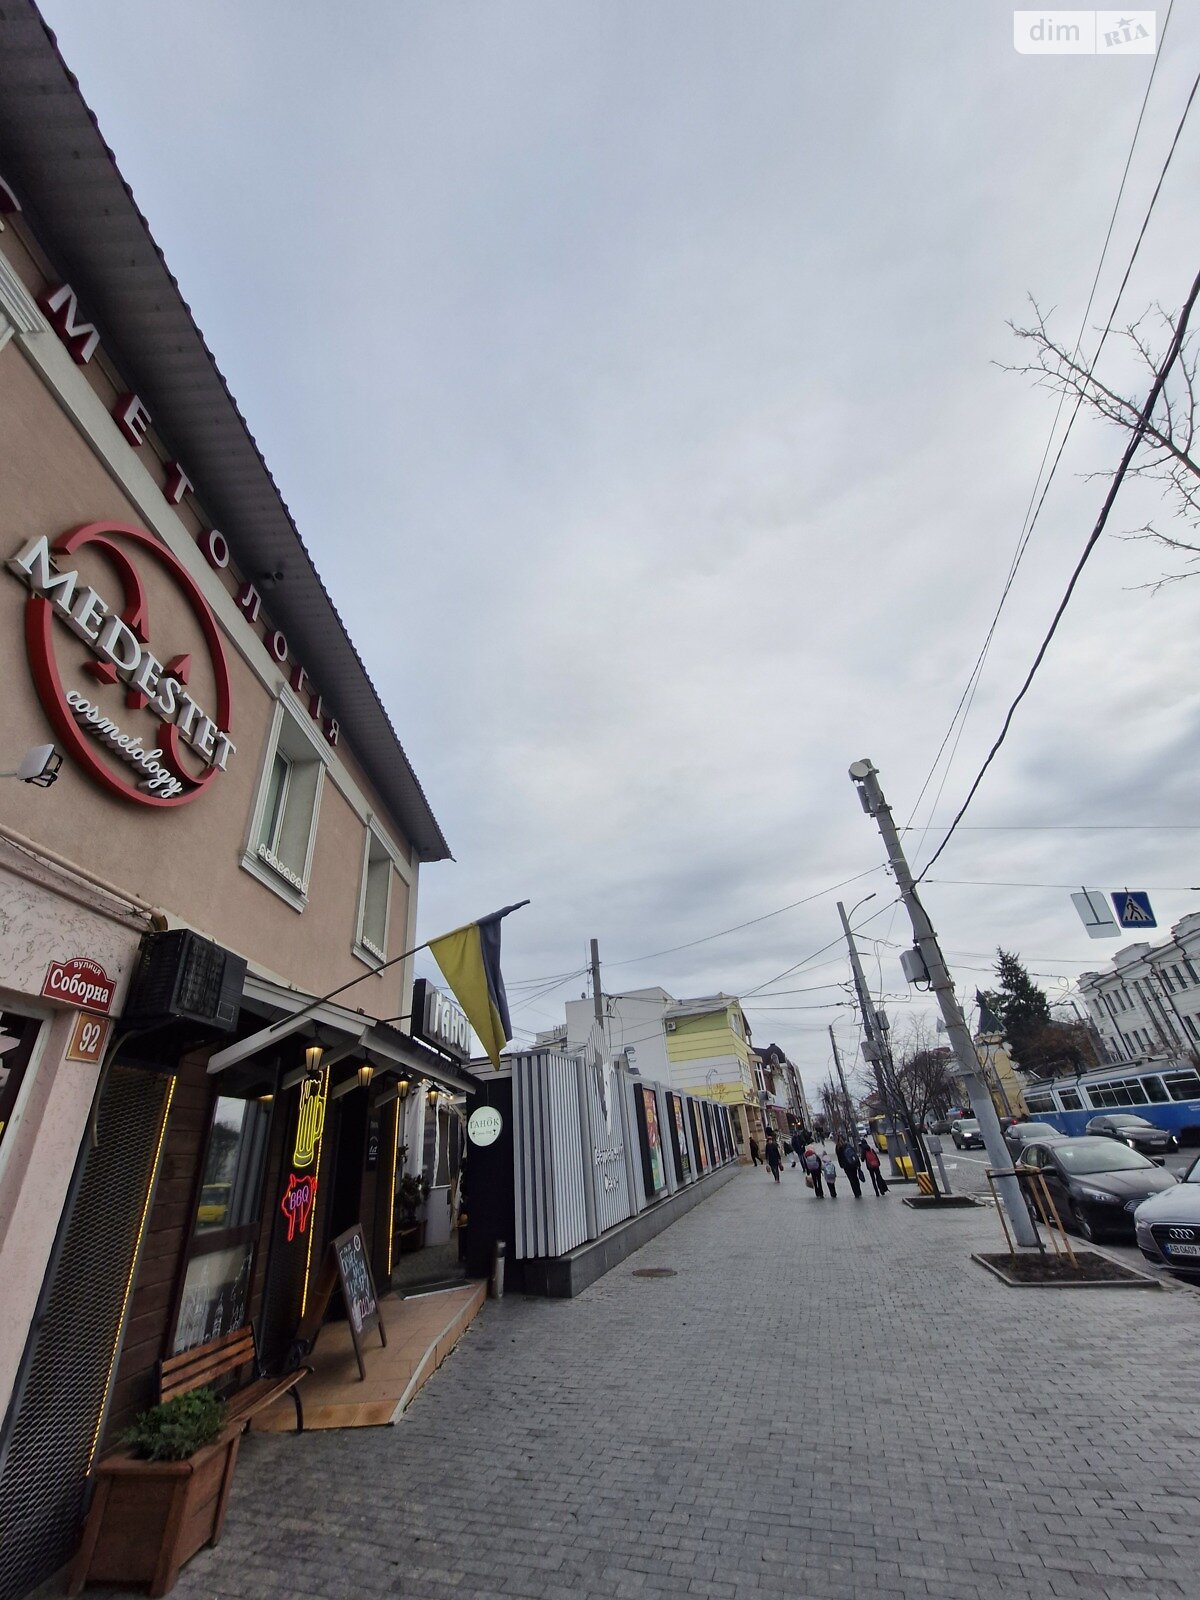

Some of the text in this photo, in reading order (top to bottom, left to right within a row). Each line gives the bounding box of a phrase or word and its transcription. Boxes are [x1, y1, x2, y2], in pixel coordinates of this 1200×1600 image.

[12, 534, 237, 773] MEDESTET
[65, 689, 183, 799] cosmetology
[73, 961, 101, 976] вулиця
[51, 968, 109, 1004] Соборна
[79, 1022, 101, 1053] 92
[290, 1185, 309, 1210] BBQ
